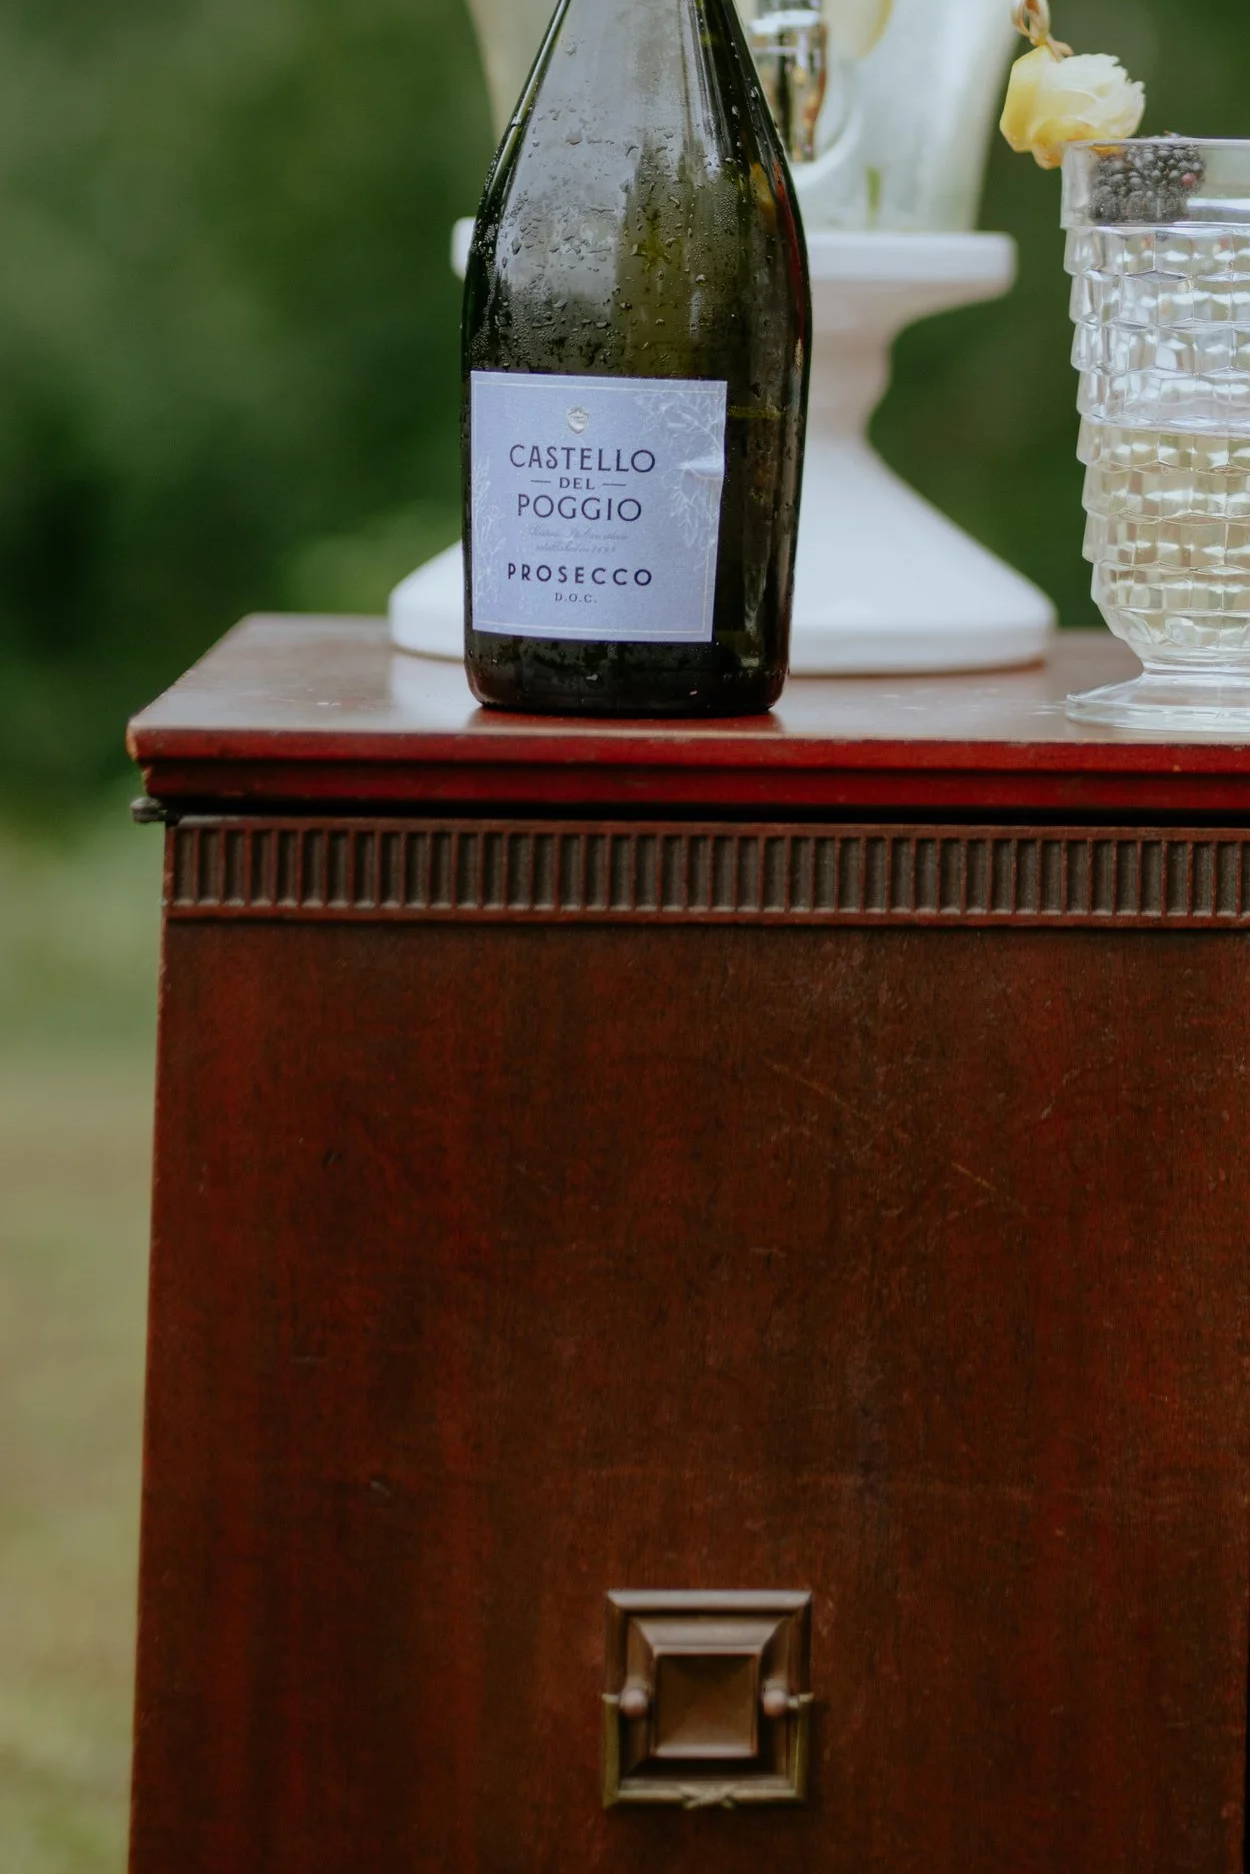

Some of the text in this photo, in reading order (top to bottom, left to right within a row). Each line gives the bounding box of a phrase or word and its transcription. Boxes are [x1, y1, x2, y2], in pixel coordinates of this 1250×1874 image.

[509, 444, 656, 473] CASTELLO
[558, 476, 595, 490] DEL
[517, 493, 642, 522] POGGIO
[507, 562, 653, 587] PROSECCO
[554, 592, 598, 604] D.O.C.
